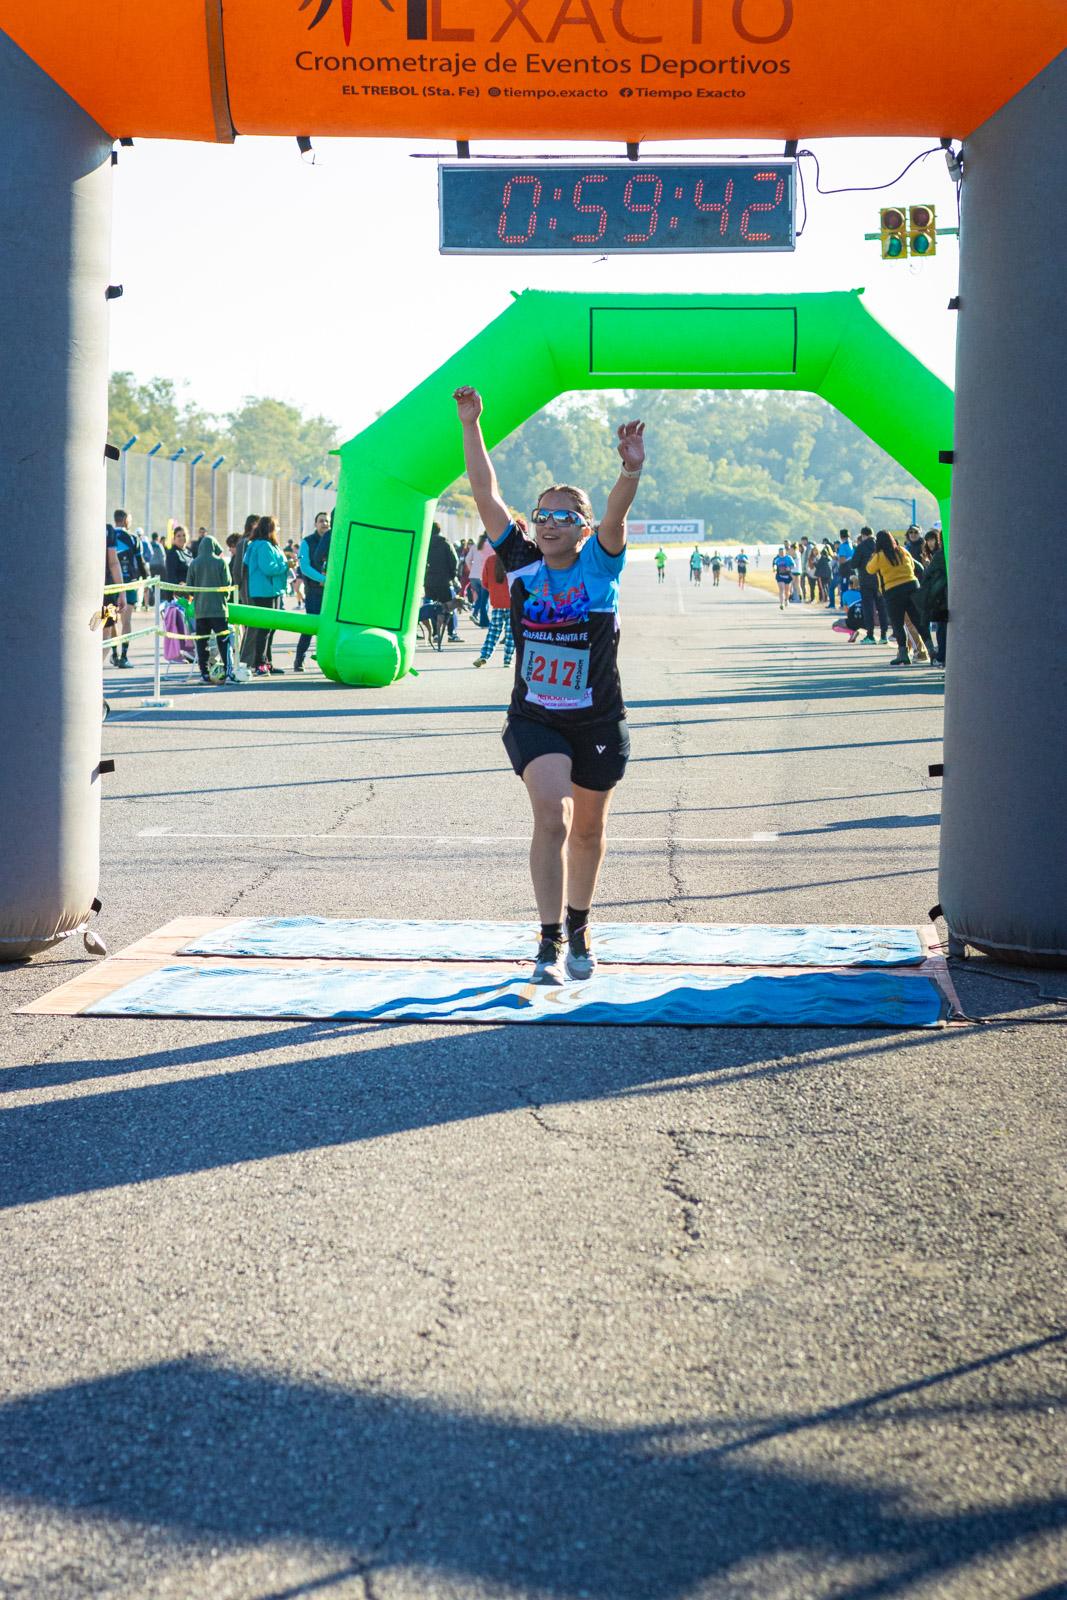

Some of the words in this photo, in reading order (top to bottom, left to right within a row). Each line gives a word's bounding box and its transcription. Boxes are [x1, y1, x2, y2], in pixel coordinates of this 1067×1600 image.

[296, 51, 476, 76] Cronometraje
[484, 53, 517, 73] de
[527, 54, 632, 74] Eventos
[641, 54, 791, 78] Deportivos
[342, 85, 359, 95] EL
[362, 85, 419, 95] TREBOL
[422, 86, 455, 97] (Sta.
[458, 87, 480, 97] Fe)
[503, 87, 608, 99] tiempo.exacto
[635, 88, 693, 99] Tiempo
[696, 88, 746, 98] Exacto
[498, 173, 784, 243] 0:59:42
[650, 524, 695, 533] LONG
[555, 632, 578, 641] SANTA
[579, 632, 588, 641] FE
[531, 655, 577, 687] 217
